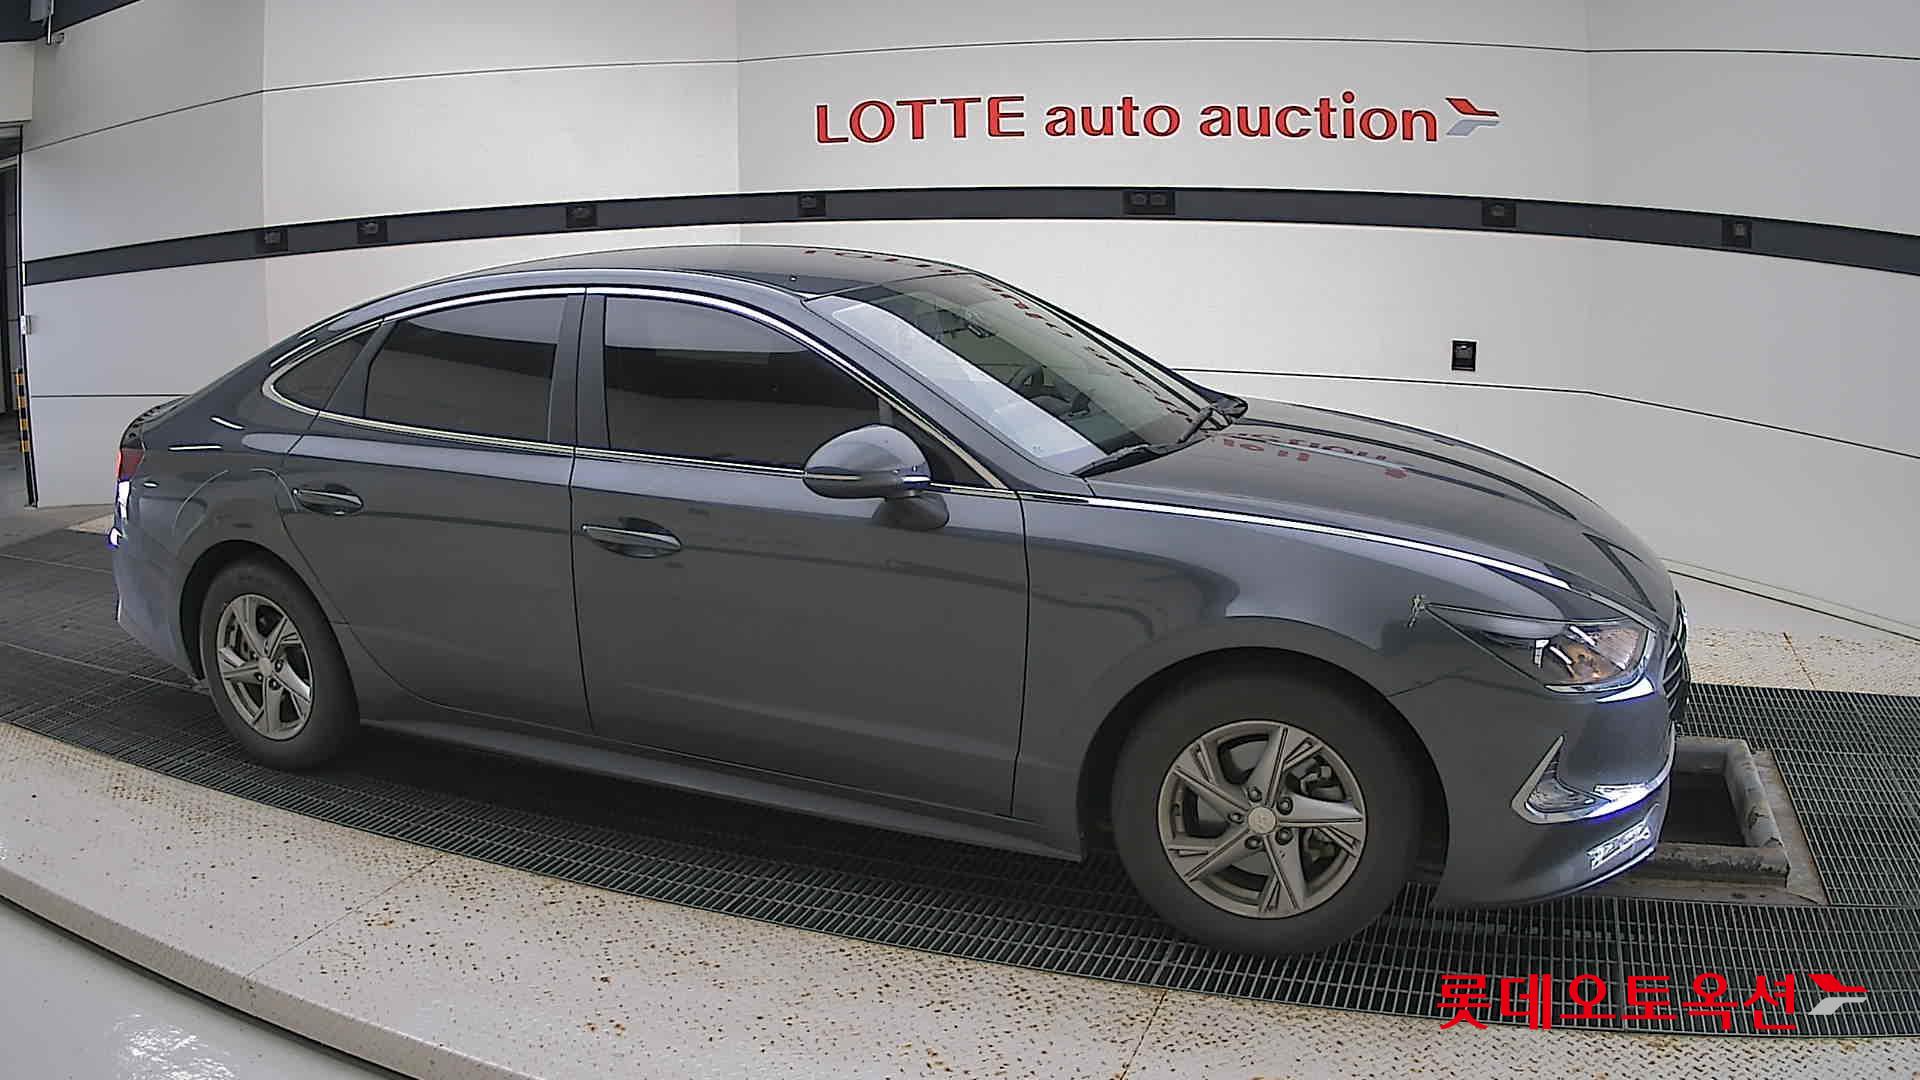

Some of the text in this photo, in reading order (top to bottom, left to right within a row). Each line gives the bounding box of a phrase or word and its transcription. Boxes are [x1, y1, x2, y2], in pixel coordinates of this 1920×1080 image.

[815, 91, 1438, 144] LOTTE auto auction
